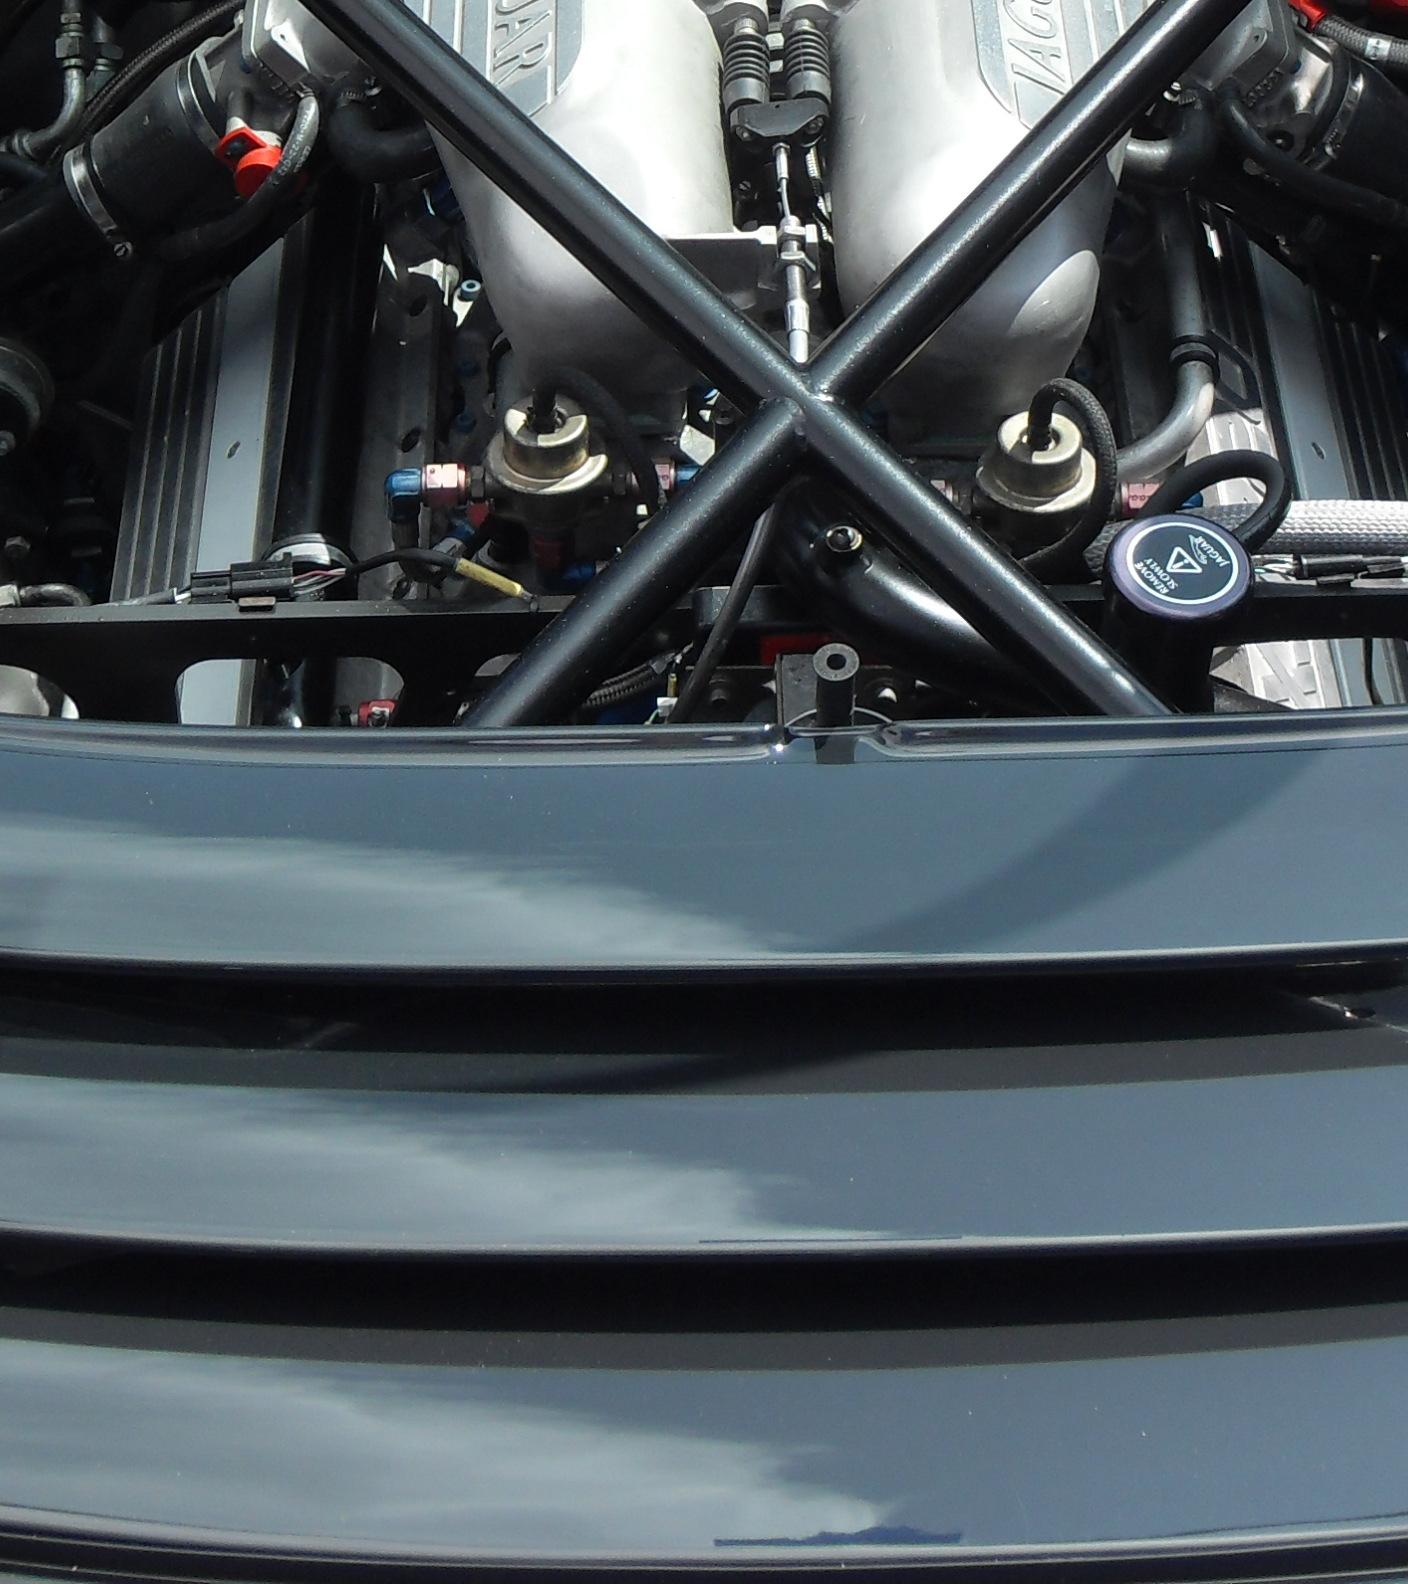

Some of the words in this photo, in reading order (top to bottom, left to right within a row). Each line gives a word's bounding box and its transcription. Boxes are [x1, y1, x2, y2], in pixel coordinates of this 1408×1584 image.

[1193, 535, 1231, 567] JAGUAR
[1134, 562, 1169, 594] REMOVE
[1143, 558, 1179, 590] SLOWLY
